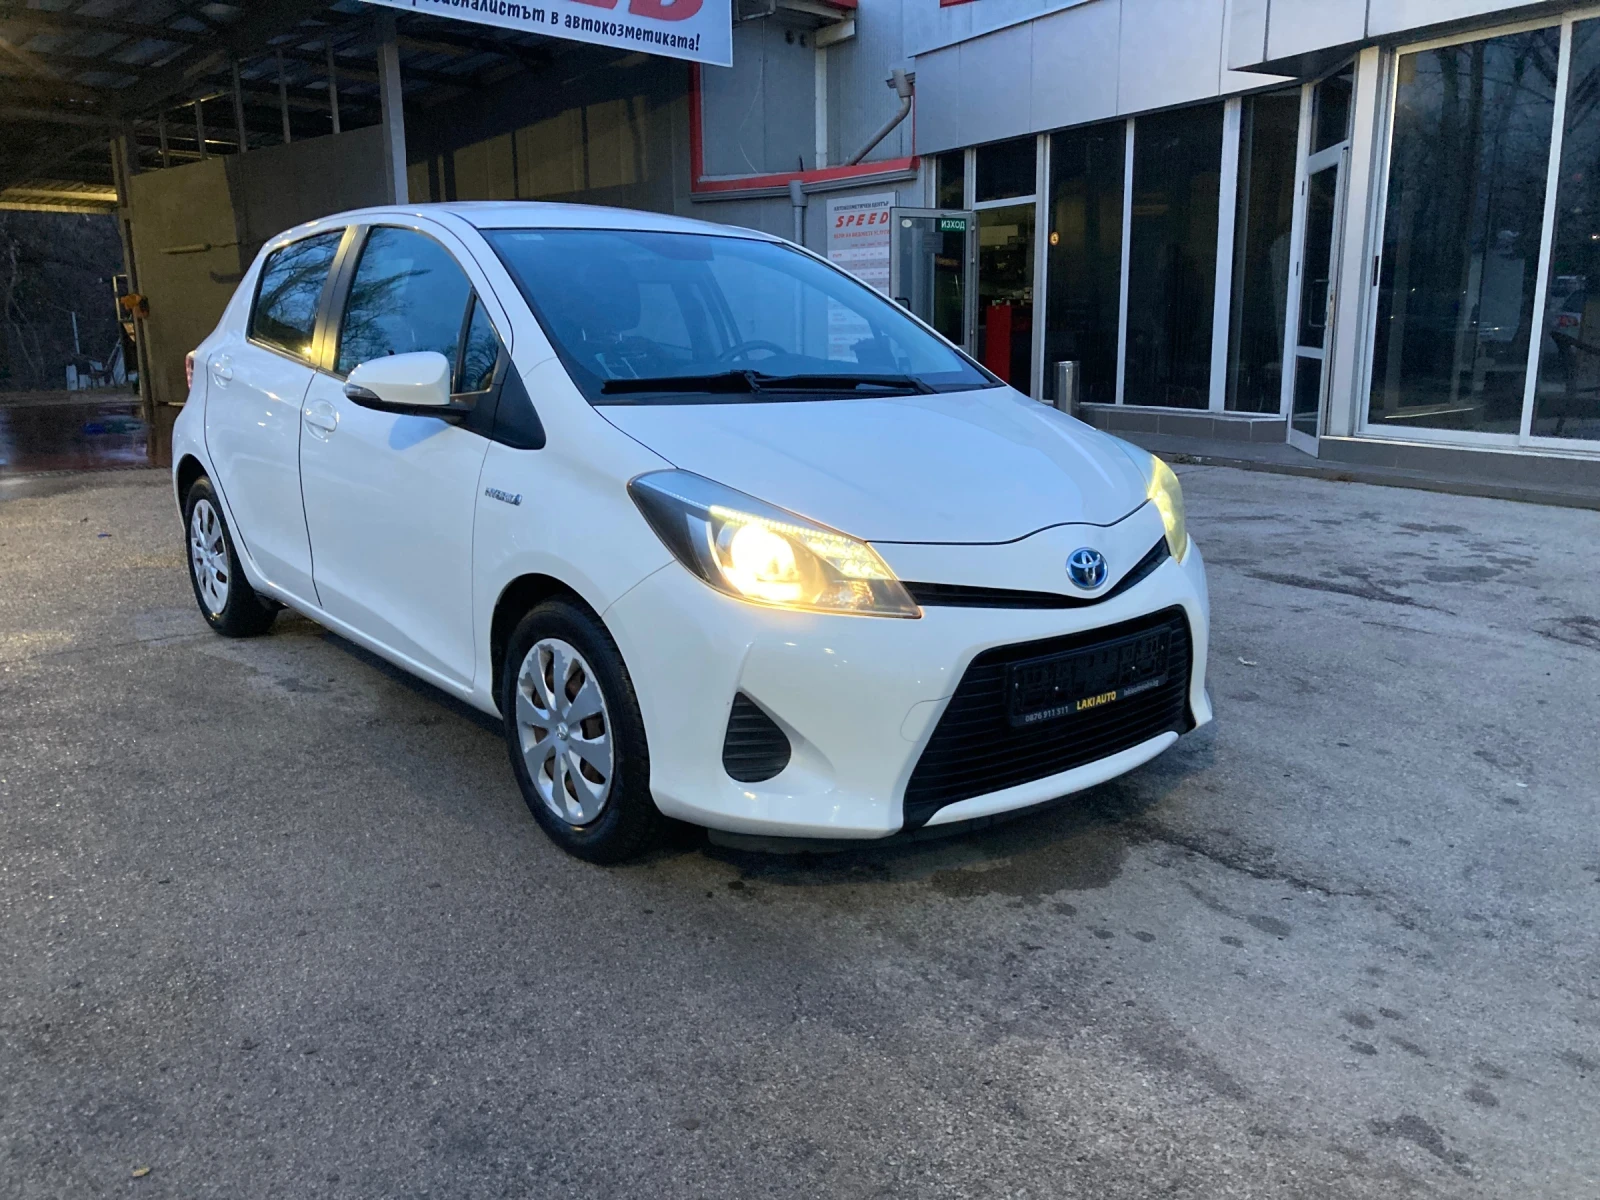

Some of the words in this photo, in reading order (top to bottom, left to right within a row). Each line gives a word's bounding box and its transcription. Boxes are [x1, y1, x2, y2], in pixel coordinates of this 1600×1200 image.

[550, 12, 559, 25] в
[564, 14, 701, 51] автокозметиката!
[835, 211, 889, 228] SPEED
[941, 220, 965, 230] ИЗХОД
